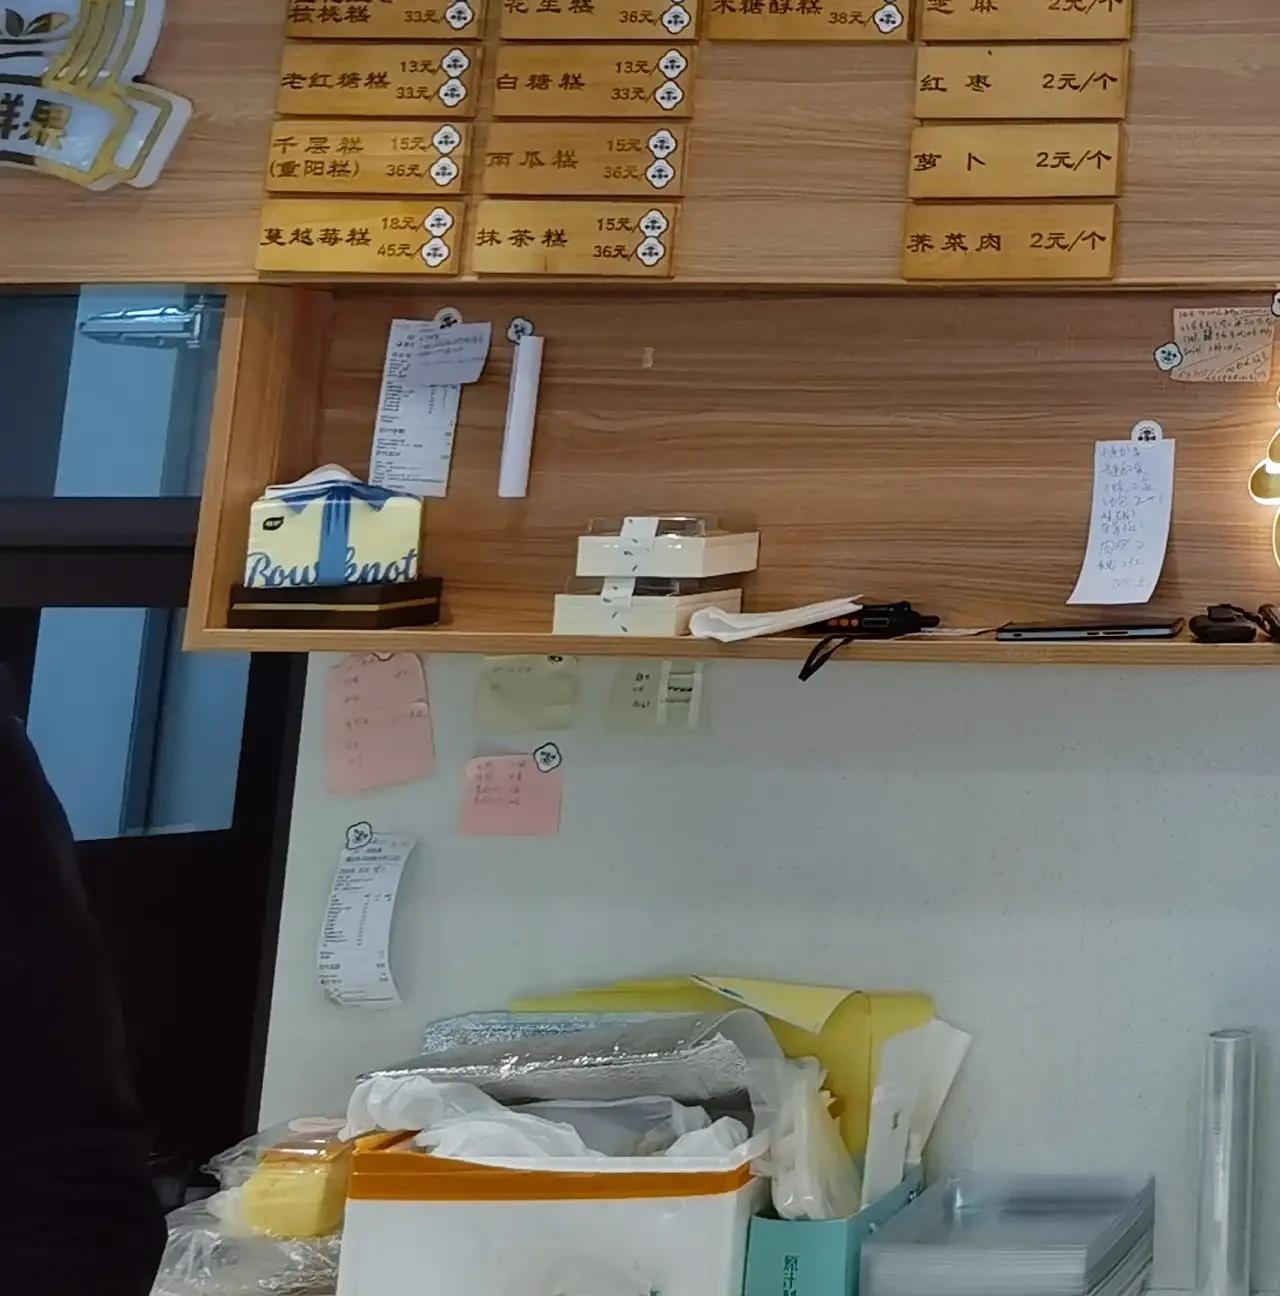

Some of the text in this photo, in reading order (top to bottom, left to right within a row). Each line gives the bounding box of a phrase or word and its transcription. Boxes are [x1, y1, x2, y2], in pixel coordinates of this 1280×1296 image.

[289, 6, 371, 23] 核桃糕
[281, 72, 391, 89] 老红糖糕
[497, 73, 586, 90] 白糖糕
[920, 72, 1118, 92] 红枣 2元/个
[272, 137, 364, 153] 千层糕
[270, 160, 359, 178] (重阳糕)
[914, 149, 1111, 171] 萝卜 2元/个
[260, 228, 372, 246] 蔓越莓糕
[477, 228, 568, 248] 抹茶糕
[906, 230, 1106, 253] 荠菜肉 2元/个
